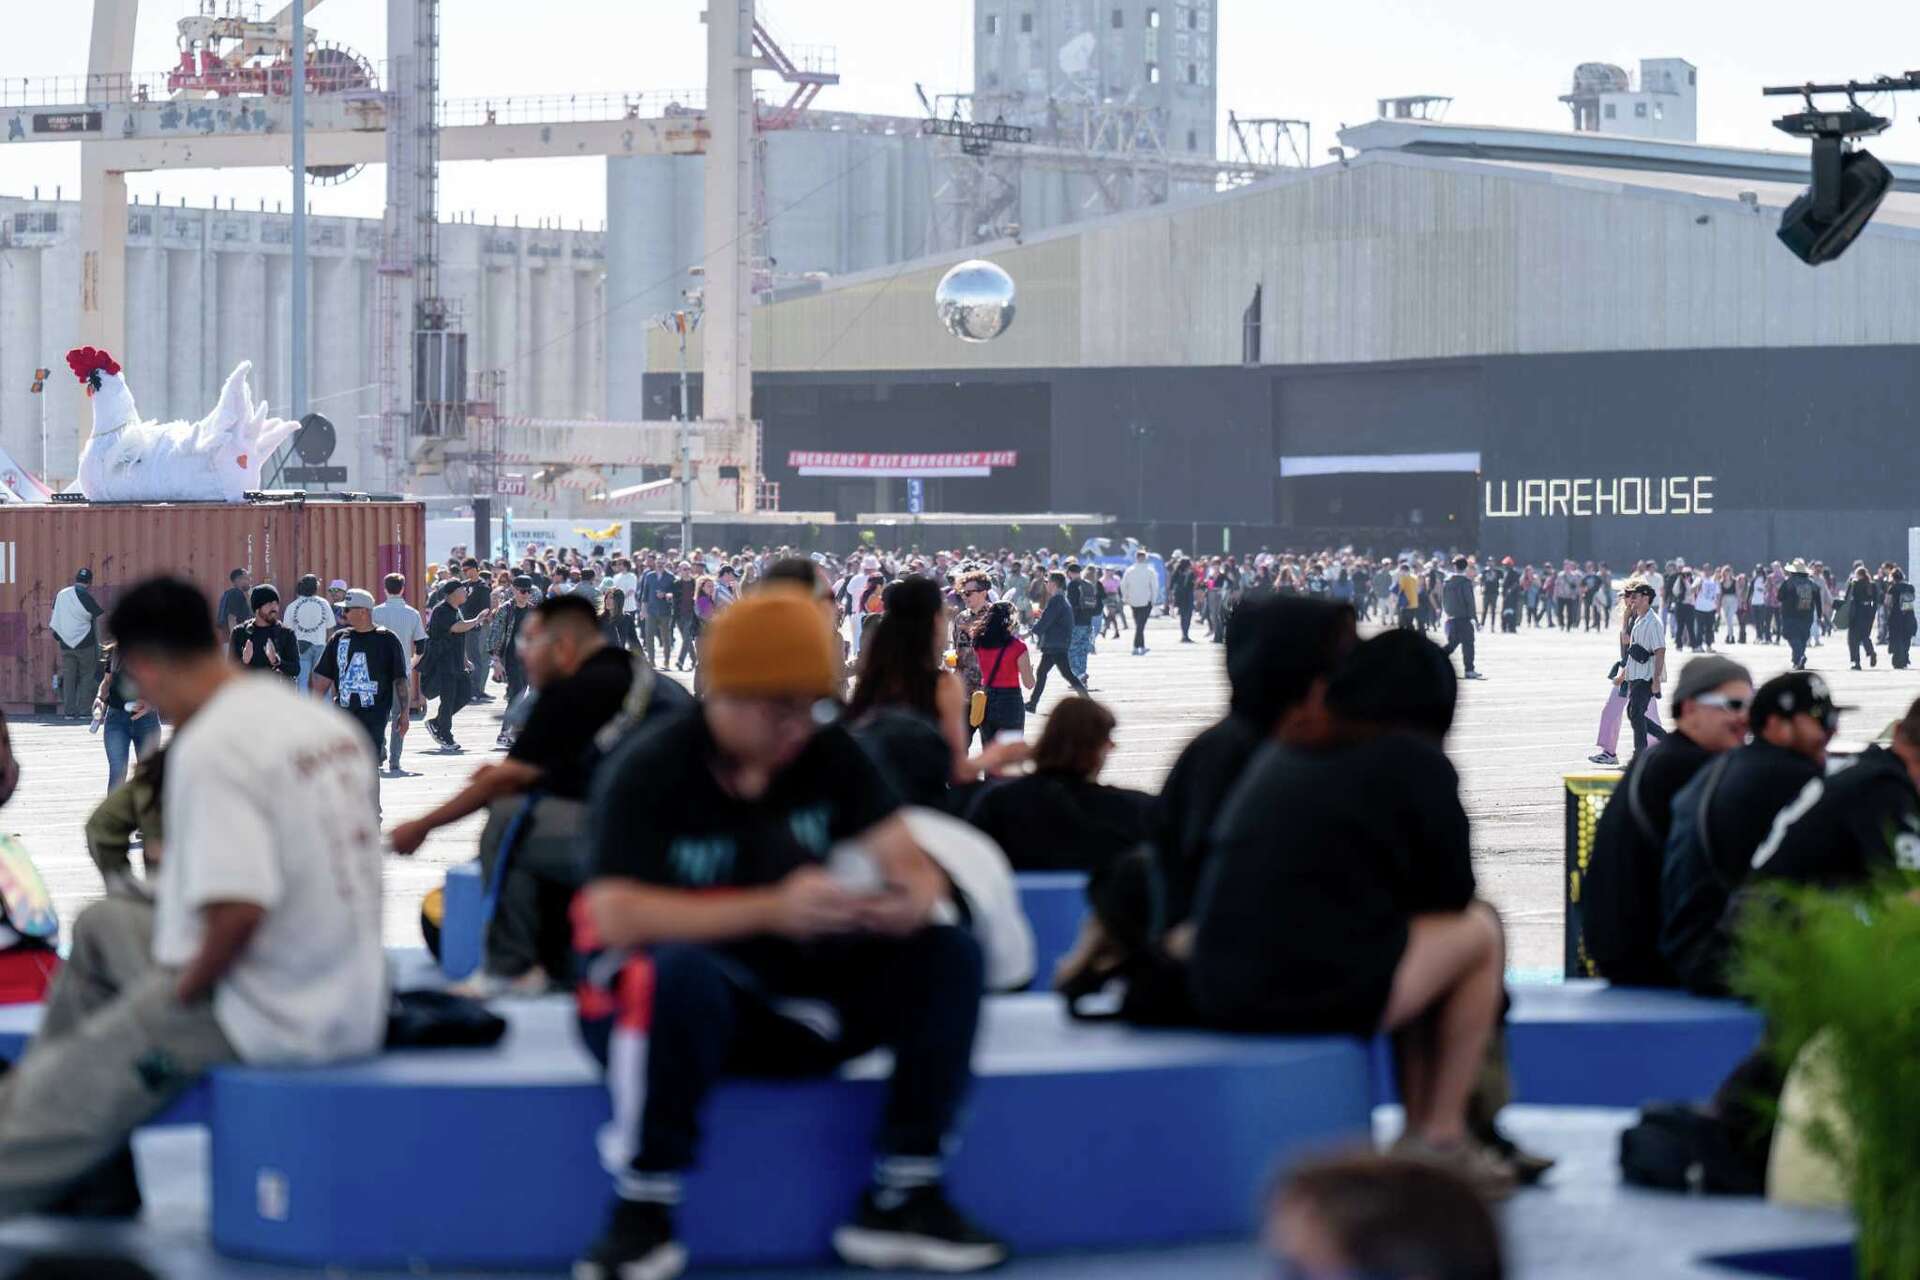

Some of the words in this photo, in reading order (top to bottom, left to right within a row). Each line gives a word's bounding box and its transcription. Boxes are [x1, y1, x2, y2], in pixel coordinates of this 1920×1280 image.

[788, 452, 865, 467] EMERGENCY
[869, 454, 899, 467] EXIT
[900, 453, 979, 467] EMERGENCY
[983, 451, 1017, 466] EXIT
[498, 480, 524, 494] EXIT
[1485, 476, 1714, 517] WAREHOUSE
[337, 639, 378, 707] LA
